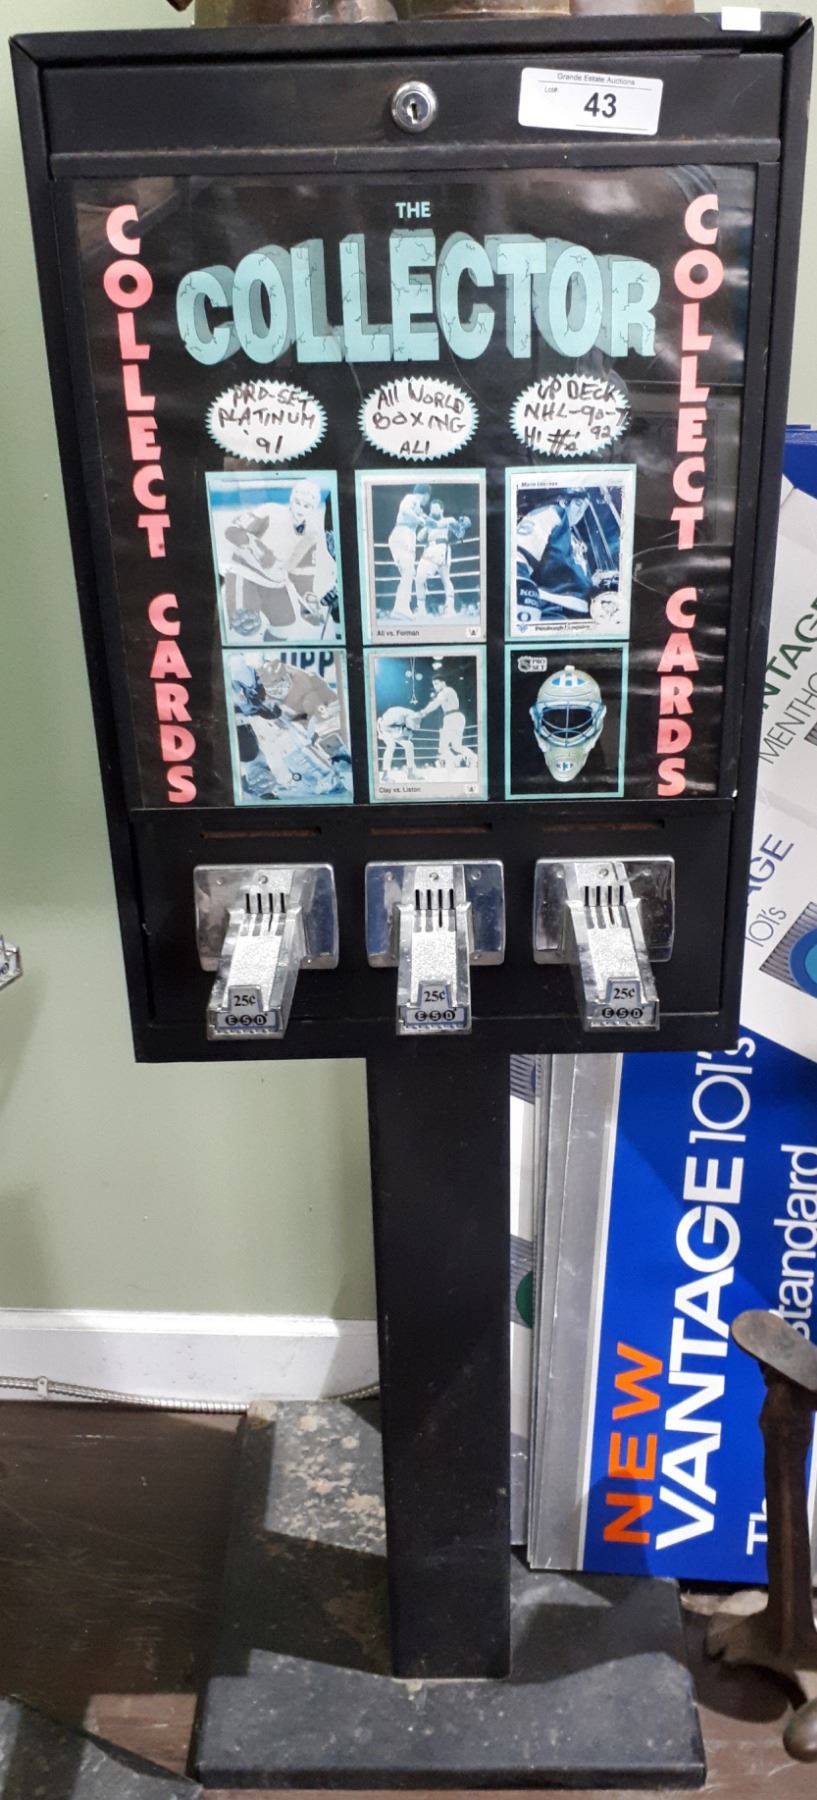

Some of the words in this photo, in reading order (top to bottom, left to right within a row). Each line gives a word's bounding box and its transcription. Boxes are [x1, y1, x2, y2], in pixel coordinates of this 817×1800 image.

[557, 72, 582, 81] Grande
[584, 74, 605, 83] Estate
[606, 77, 635, 86] Auctions
[584, 92, 617, 118] 43
[396, 201, 431, 218] THE
[176, 229, 661, 366] COLLECTOR
[671, 193, 724, 551] COLLECT
[537, 379, 561, 400] UP
[567, 380, 616, 402] DECK
[218, 407, 316, 429] PLATINUM
[372, 411, 466, 433] BOXING
[400, 440, 430, 455] ALI
[103, 204, 170, 559] COLLECT
[148, 593, 197, 804] CARDS
[656, 586, 700, 797] CARDS
[233, 994, 256, 1007] 25¢
[424, 990, 446, 1002] 25¢
[613, 988, 635, 1000] 25¢
[655, 1155, 744, 1551] VANTAGE
[603, 1341, 663, 1545] NEW
